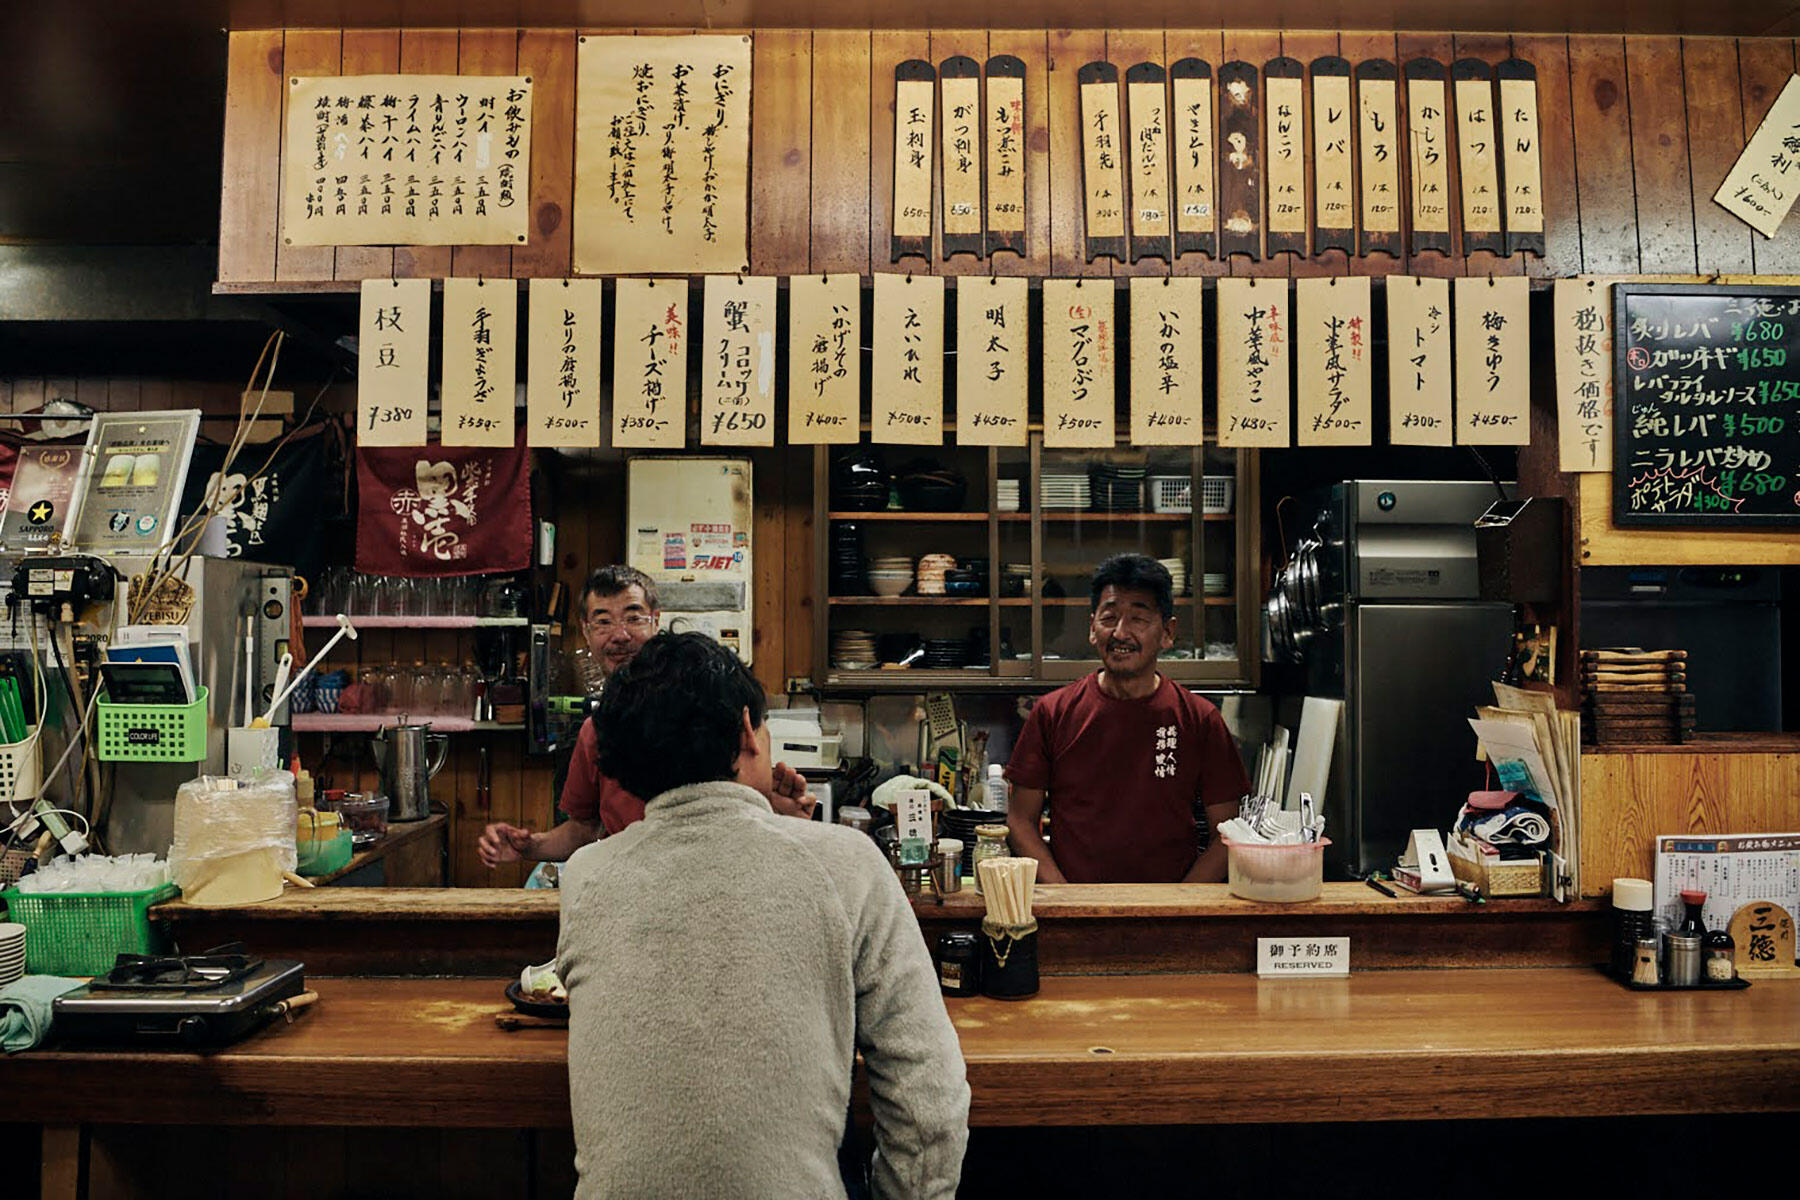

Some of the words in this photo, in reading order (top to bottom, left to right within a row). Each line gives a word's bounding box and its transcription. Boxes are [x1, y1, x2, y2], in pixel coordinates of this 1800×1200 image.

[405, 94, 421, 162] ライムハイ
[429, 94, 449, 165] 青りんごハイ
[452, 94, 468, 163] ウーロンハイ
[1093, 109, 1114, 169] 手羽先
[1187, 104, 1204, 167] やきとり
[1277, 104, 1292, 158] なんこつ
[1326, 107, 1345, 154] レバ
[1421, 106, 1440, 166] かしら
[1468, 108, 1487, 155] はつ
[1513, 107, 1531, 153] たん
[374, 305, 405, 369] 枝豆
[724, 300, 750, 333] 蟹
[832, 304, 851, 378] いかげその
[1731, 320, 1784, 341] ¥680
[471, 307, 494, 403] 手羽ぎょうざ
[558, 308, 580, 410] とりの唐揚げ
[717, 338, 732, 388] クリーム
[811, 334, 833, 398] 唐揚げ
[986, 304, 1009, 382] 明太子
[1070, 324, 1093, 401] マグロぶつ
[1243, 306, 1270, 404] 中華風やっこ
[1323, 315, 1351, 416] 中華風サラダ
[1409, 327, 1427, 392] トマト
[1737, 348, 1787, 370] ¥650
[640, 324, 667, 415] チーズ揚げ
[736, 346, 752, 397] コロッケ
[1571, 305, 1605, 467] 税抜き価格です
[1634, 374, 1704, 393] レバフライ
[368, 406, 413, 431] ¥380
[712, 411, 766, 434] ¥650
[1659, 387, 1756, 406] タルタルソース
[1632, 412, 1717, 438] 純レバ
[1722, 413, 1785, 437] ¥500
[1631, 445, 1772, 471] ニラレバ炒め
[1720, 470, 1786, 497] ¥680
[1631, 475, 1675, 510] ポテト
[1651, 474, 1700, 513] サラダ
[1270, 943, 1338, 957] 御予約席
[1274, 961, 1333, 969] RESERVED
